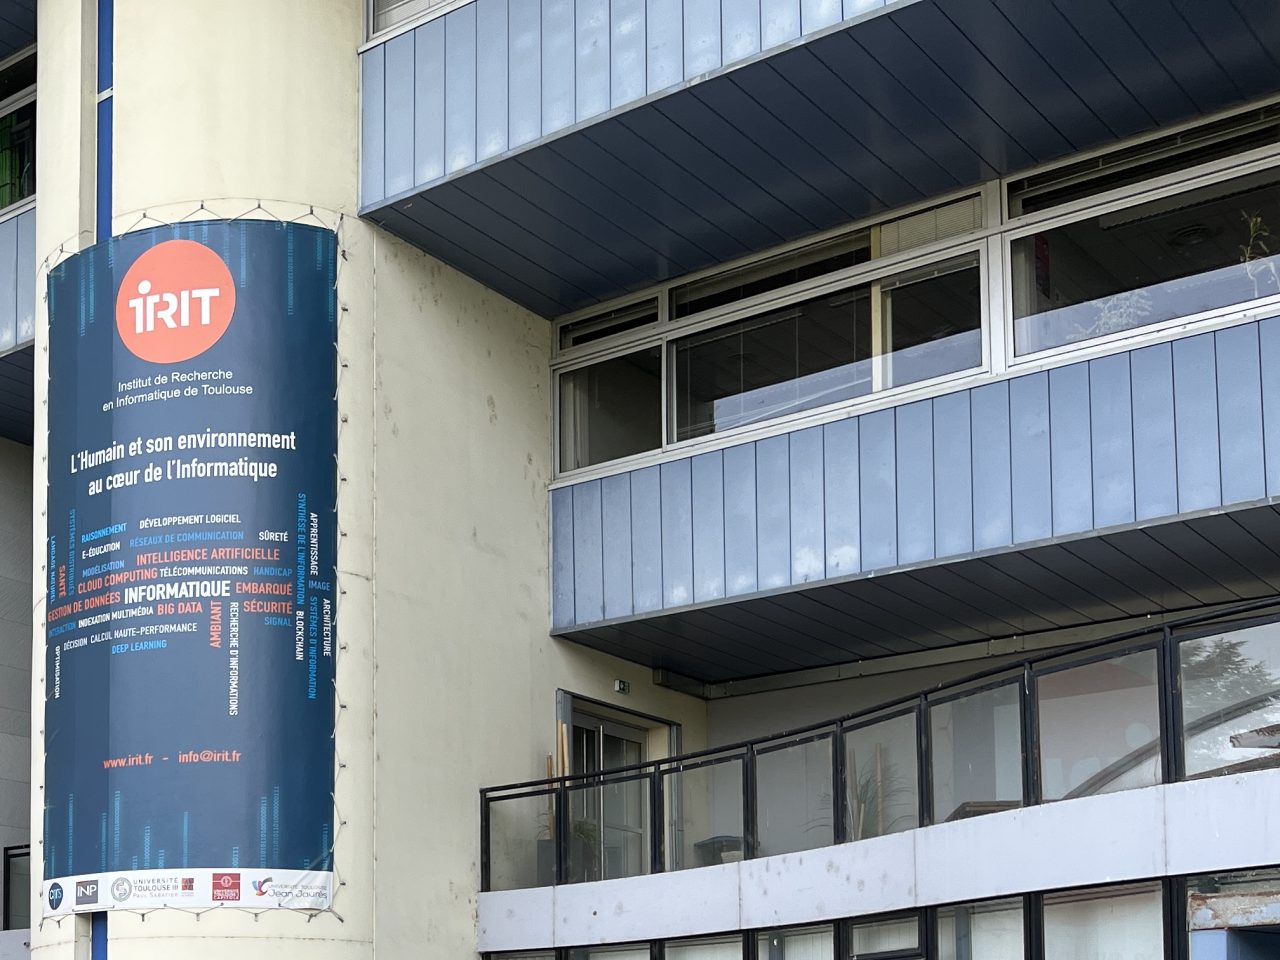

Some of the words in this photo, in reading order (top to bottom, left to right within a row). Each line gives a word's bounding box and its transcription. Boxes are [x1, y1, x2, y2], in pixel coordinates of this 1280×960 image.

[118, 377, 151, 393] Institut
[154, 374, 168, 385] de
[172, 369, 233, 383] Recherche
[102, 401, 114, 412] en
[116, 387, 181, 408] Informatique
[184, 385, 198, 397] de
[202, 383, 253, 396] Toulouse
[129, 436, 143, 456] et
[146, 434, 173, 453] son
[178, 428, 296, 450] environnement
[88, 478, 103, 496] au
[106, 468, 141, 491] cœur
[144, 463, 162, 483] de
[139, 514, 204, 530] DÉVELOPPEMENT
[206, 514, 241, 524] LOGICIEL
[81, 522, 127, 543] RAISONNEMENT
[129, 534, 163, 548] RÉSEAUX
[165, 534, 175, 543] DE
[177, 530, 244, 542] COMMUNICATION
[297, 534, 306, 545] DE
[310, 512, 319, 576] APPRENTISSAGE
[136, 548, 208, 566] INTELLIGENCE
[210, 547, 280, 561] ARTIFICIELLE
[77, 577, 103, 594] CLOUD
[104, 567, 158, 587] COMPUTING
[159, 565, 249, 578] TÉLÉCOMMUNICATIONS
[253, 567, 293, 577] HANDICAP
[124, 580, 231, 604] INFORMATIQUE
[235, 581, 293, 596] EMBARQUÉ
[308, 580, 331, 591] IMAGE
[47, 605, 72, 622] GESTION
[73, 601, 82, 613] DE
[84, 591, 121, 610] DONNÉES
[157, 603, 174, 616] BIG
[178, 602, 203, 614] DATA
[243, 599, 293, 614] SÉCURITÉ
[78, 612, 111, 628] INDEXATION
[111, 606, 154, 620] MULTIMÉDIA
[209, 600, 222, 649] AMBIANT
[229, 602, 239, 648] RECHERCHE
[264, 616, 293, 627] SIGNAL
[90, 631, 112, 644] CALCUL
[114, 622, 198, 639] HAUTE-PERFORMANCE
[295, 610, 305, 661] BLOCKCHAIN
[322, 598, 332, 657] ARCHITECTURE
[63, 637, 88, 651] DÉCISION
[111, 643, 128, 655] DEEP
[130, 639, 167, 652] LEARNING
[103, 753, 154, 769] www.irit.fr
[178, 750, 242, 763] info@irit.fr
[77, 885, 97, 897] INP
